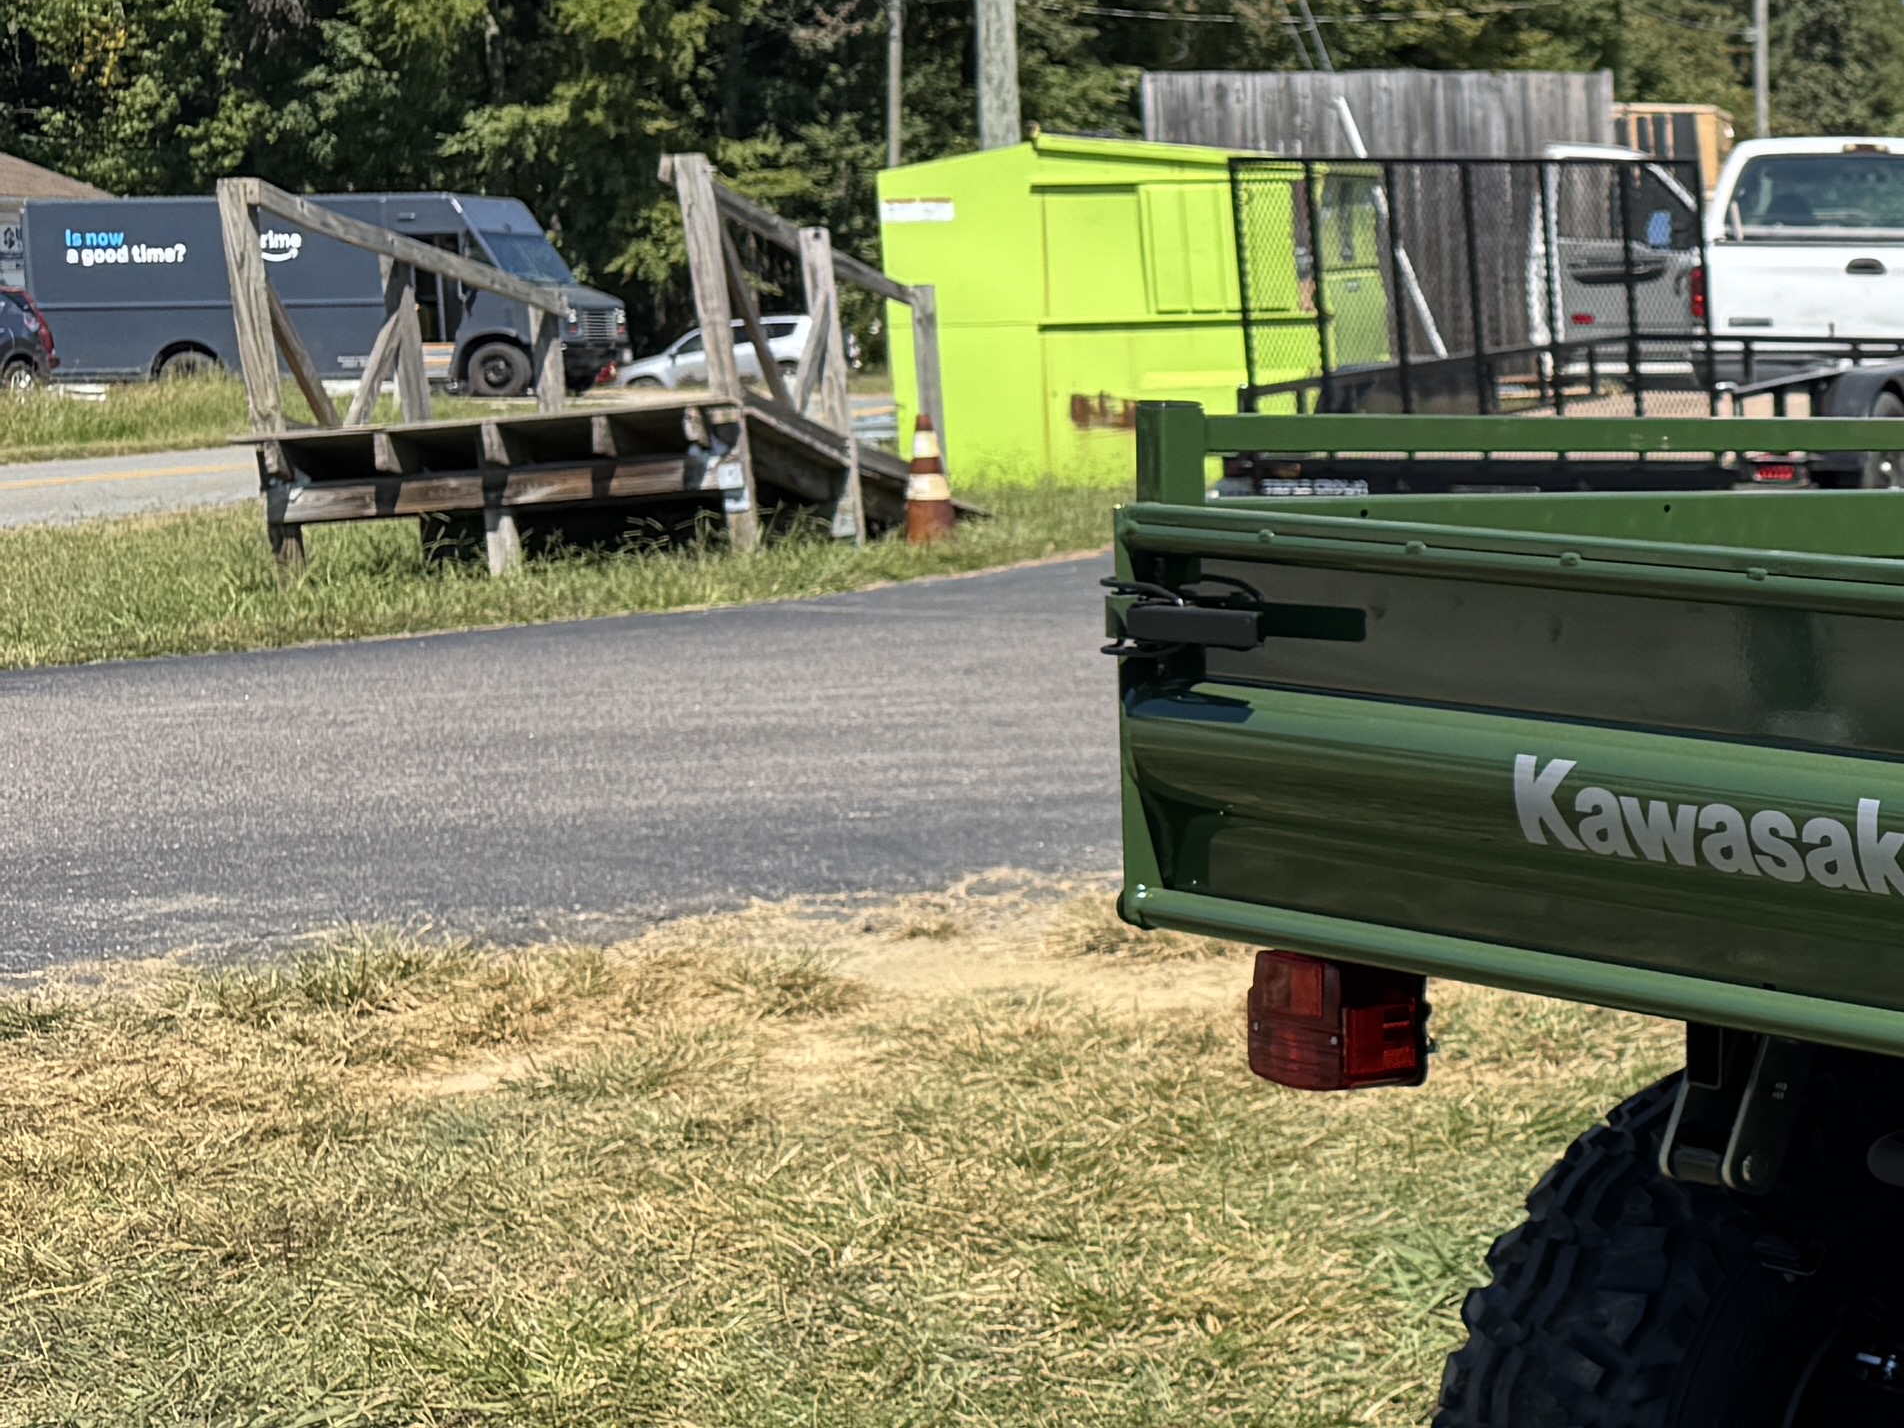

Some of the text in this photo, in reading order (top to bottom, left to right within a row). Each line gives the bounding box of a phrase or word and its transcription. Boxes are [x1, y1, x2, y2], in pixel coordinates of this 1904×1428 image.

[65, 229, 125, 247] Is now
[259, 229, 303, 250] rime
[66, 242, 187, 267] a good time?
